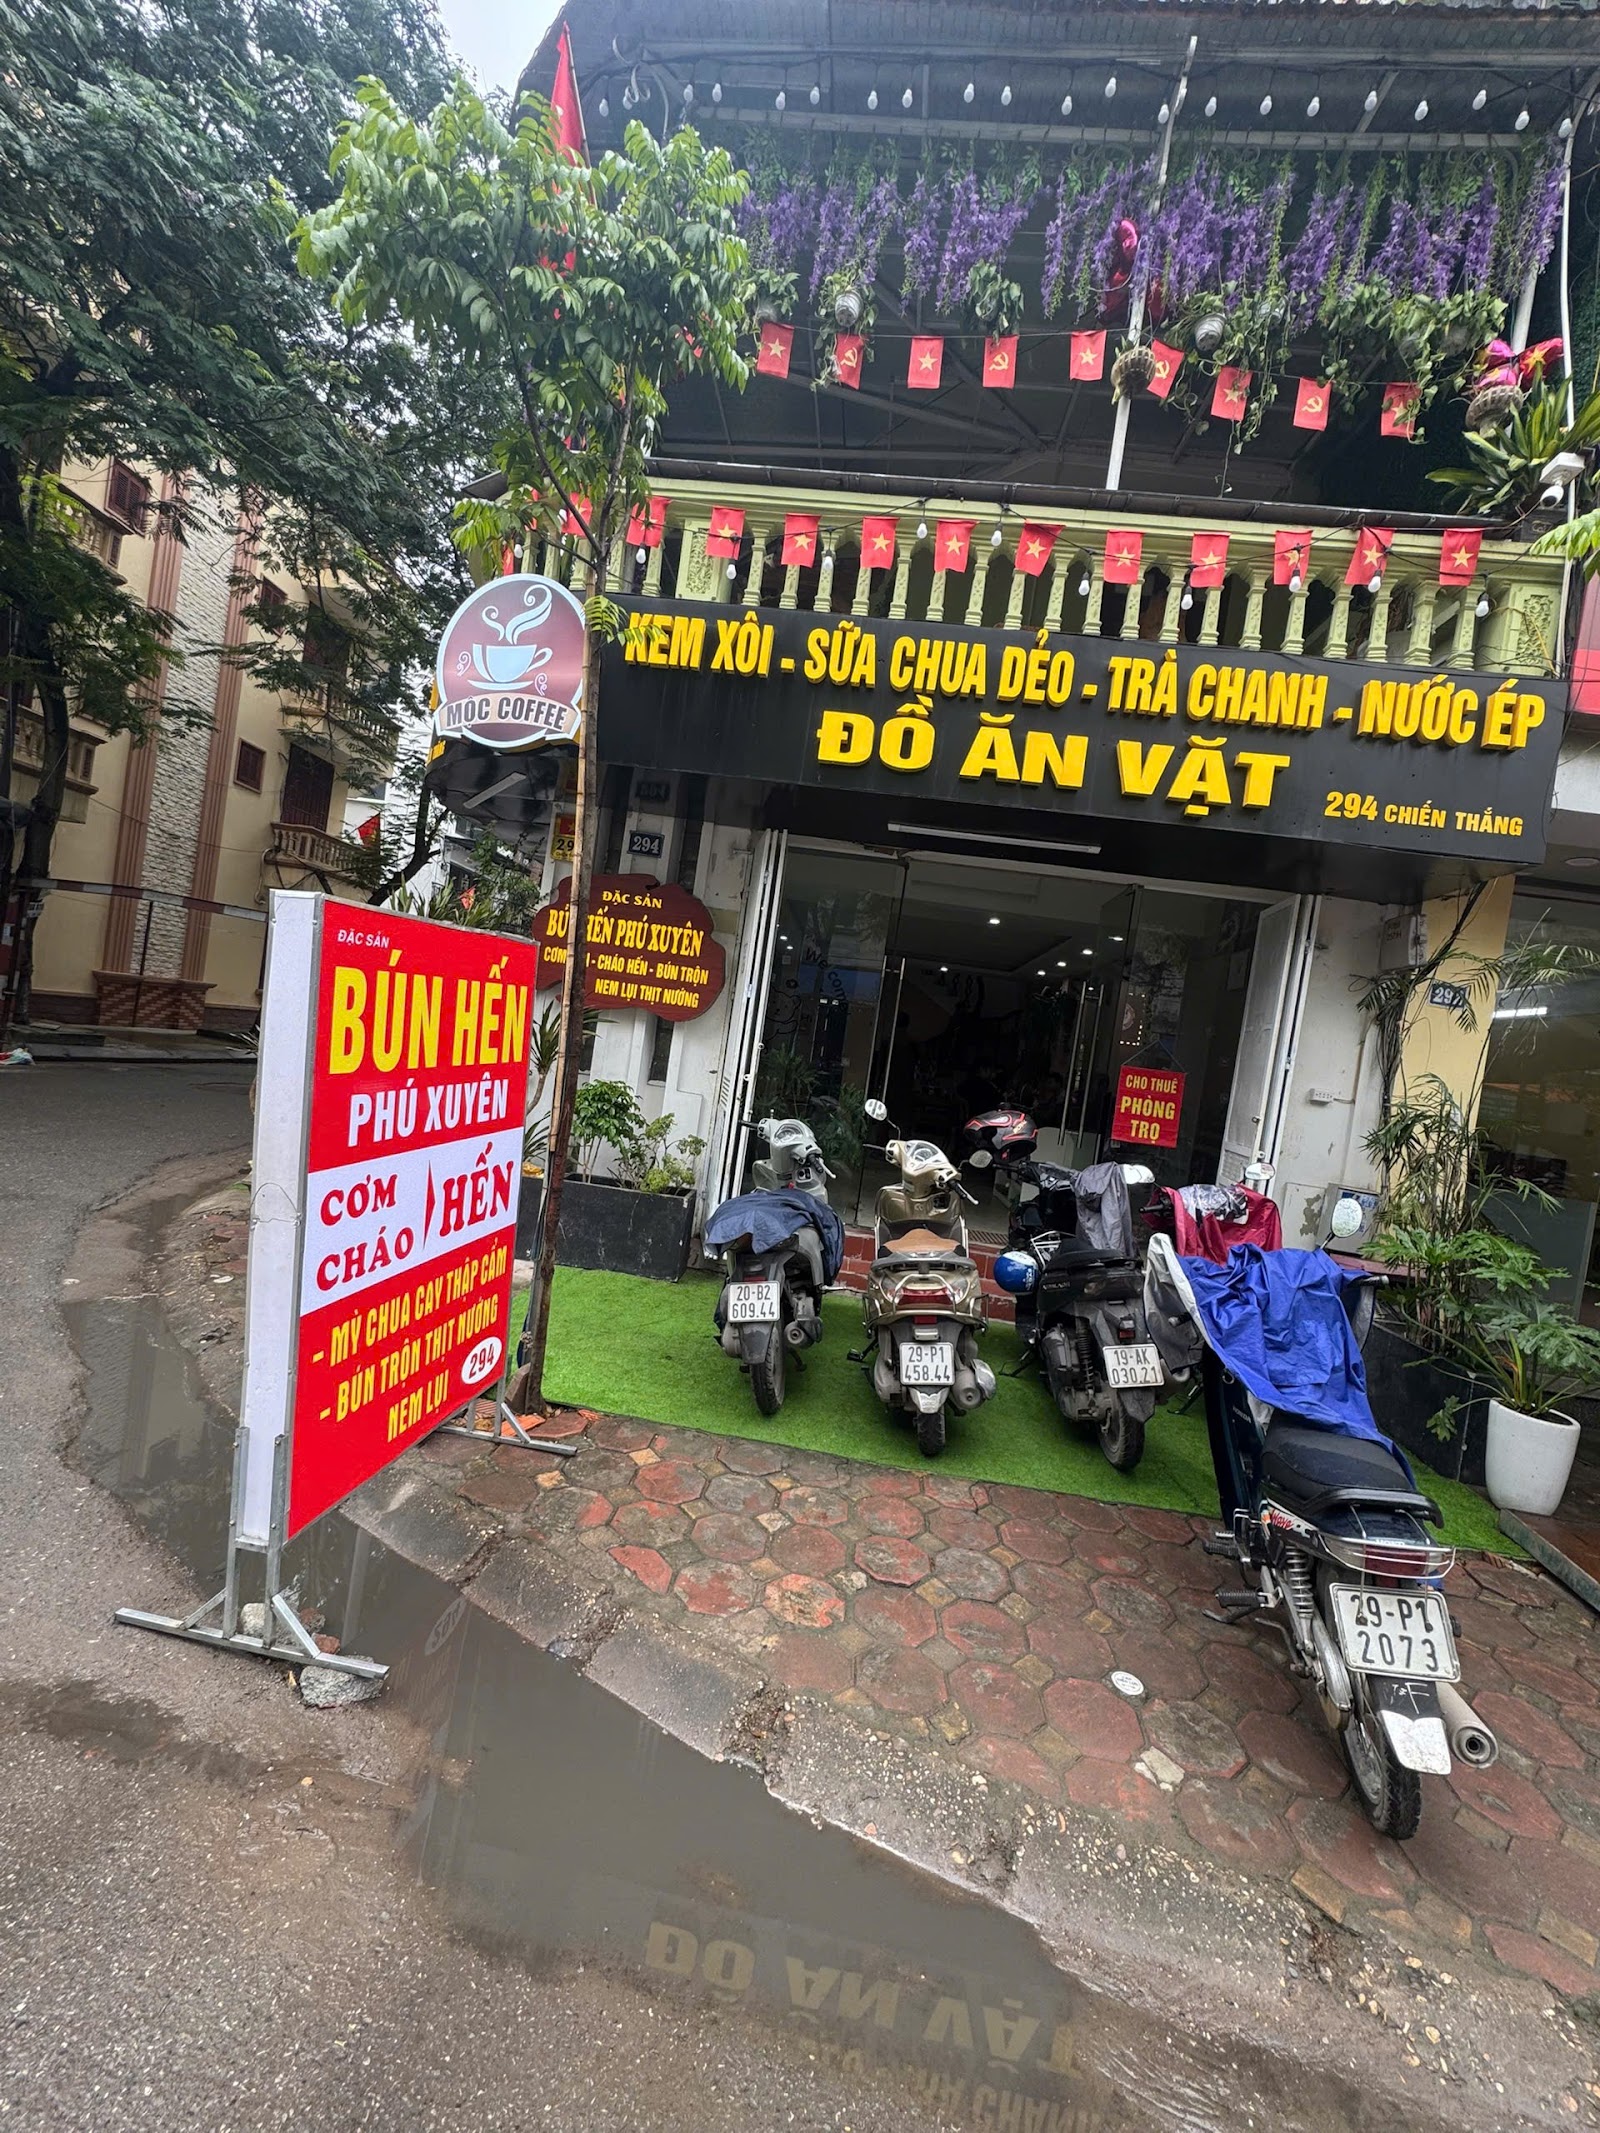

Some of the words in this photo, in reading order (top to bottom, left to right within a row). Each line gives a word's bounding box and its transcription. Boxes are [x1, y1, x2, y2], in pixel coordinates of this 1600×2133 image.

[625, 612, 706, 670] KEM
[711, 610, 774, 678] XÔI
[803, 619, 876, 688] SỮA
[889, 636, 986, 700] CHUA
[997, 628, 1075, 707] DẺO
[1108, 649, 1177, 717] TRÀ
[1187, 664, 1328, 731] CHANH
[1357, 674, 1479, 747] NƯỚC
[1480, 678, 1546, 750] ÉP
[446, 696, 490, 728] MỘC
[498, 696, 567, 730] COFFEE
[816, 694, 935, 772] ĐỒ
[959, 712, 1089, 790] ĂN
[1117, 735, 1291, 816] VẶT
[1324, 791, 1378, 821] 294
[1384, 800, 1447, 829] CHIẾN
[1455, 807, 1524, 836] THẮNG
[556, 838, 576, 852] 29
[632, 835, 660, 854] 294
[602, 890, 630, 906] ĐẶC
[634, 893, 663, 909] SẢN
[337, 929, 364, 946] ĐẶC
[366, 930, 390, 949] SẢN
[615, 915, 648, 950] PHÚ
[647, 920, 704, 957] XUYÊN
[597, 953, 625, 973] CHÁO
[626, 954, 648, 976] HẾN
[656, 961, 679, 981] BÚN
[680, 965, 709, 987] TRỘN
[595, 978, 619, 997] NEM
[620, 982, 637, 1001] LỤI
[640, 985, 662, 1005] THỊT
[662, 988, 699, 1009] NƯỚNG
[329, 950, 443, 1075] BÚN
[452, 956, 528, 1067] HẾN
[1125, 1074, 1148, 1090] CHO
[1151, 1077, 1178, 1094] THUÊ
[348, 1078, 418, 1147] PHÚ
[424, 1071, 509, 1133] XUYÊN
[1120, 1095, 1176, 1120] PHÒNG
[1130, 1119, 1160, 1144] TRỌ
[320, 1174, 398, 1226] CƠM
[439, 1141, 514, 1237] HẾN
[316, 1226, 414, 1291] CHÁO
[366, 1292, 411, 1348] CHUA
[414, 1275, 444, 1320] CAY
[446, 1256, 479, 1304] THẬP
[737, 1284, 771, 1301] 20-B2
[732, 1302, 775, 1319] 609.44
[336, 1364, 376, 1423] BÚN
[380, 1338, 421, 1394] TRỘN
[425, 1318, 455, 1365] THỊT
[457, 1293, 499, 1346] NƯỚNG
[468, 1343, 495, 1379] 294
[908, 1346, 944, 1363] 29-P1
[1113, 1348, 1151, 1366] 19-AK
[904, 1365, 950, 1382] 458.44
[1112, 1366, 1159, 1385] 030.21
[388, 1387, 423, 1443] NEM
[426, 1369, 449, 1414] LỤI
[1350, 1593, 1434, 1633] 29-P1
[1357, 1630, 1439, 1673] 2073
